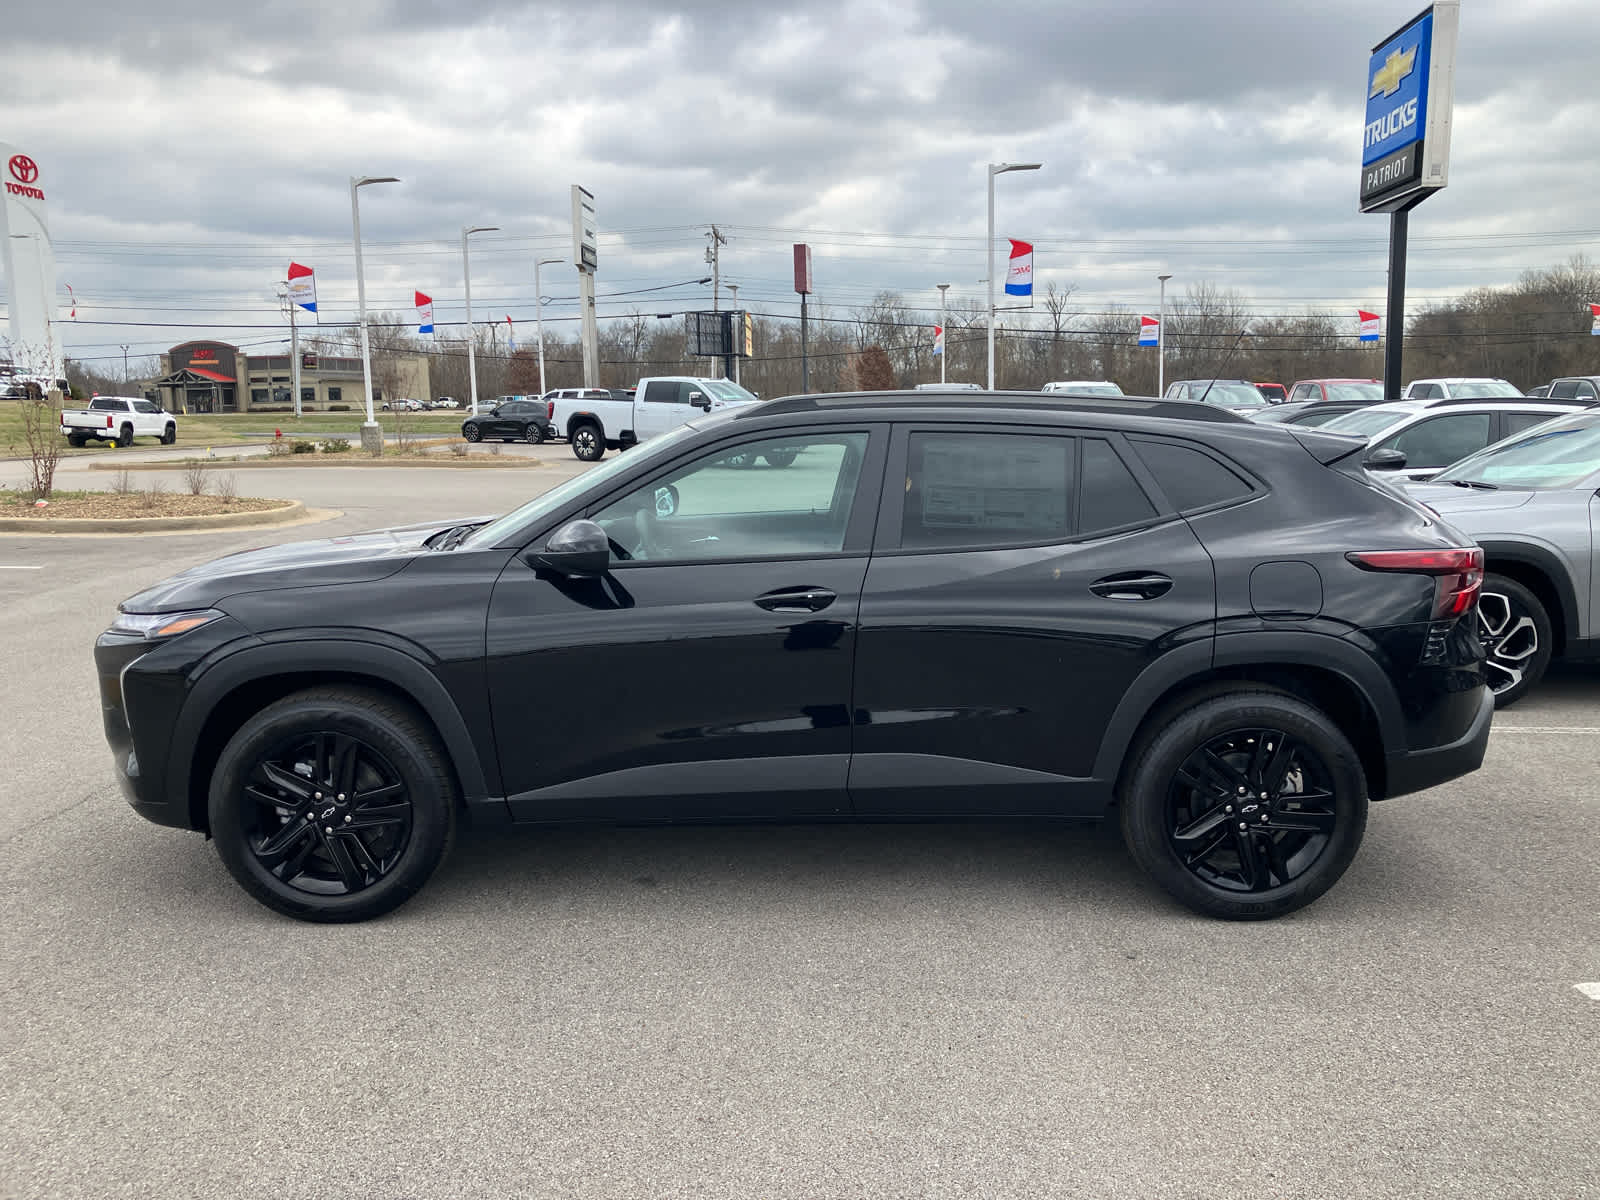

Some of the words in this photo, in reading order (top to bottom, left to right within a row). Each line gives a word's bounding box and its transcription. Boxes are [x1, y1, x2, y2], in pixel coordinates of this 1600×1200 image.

[1365, 97, 1418, 148] TRUCKS
[1367, 156, 1408, 190] PATRIOT
[5, 181, 45, 200] TOYOTA
